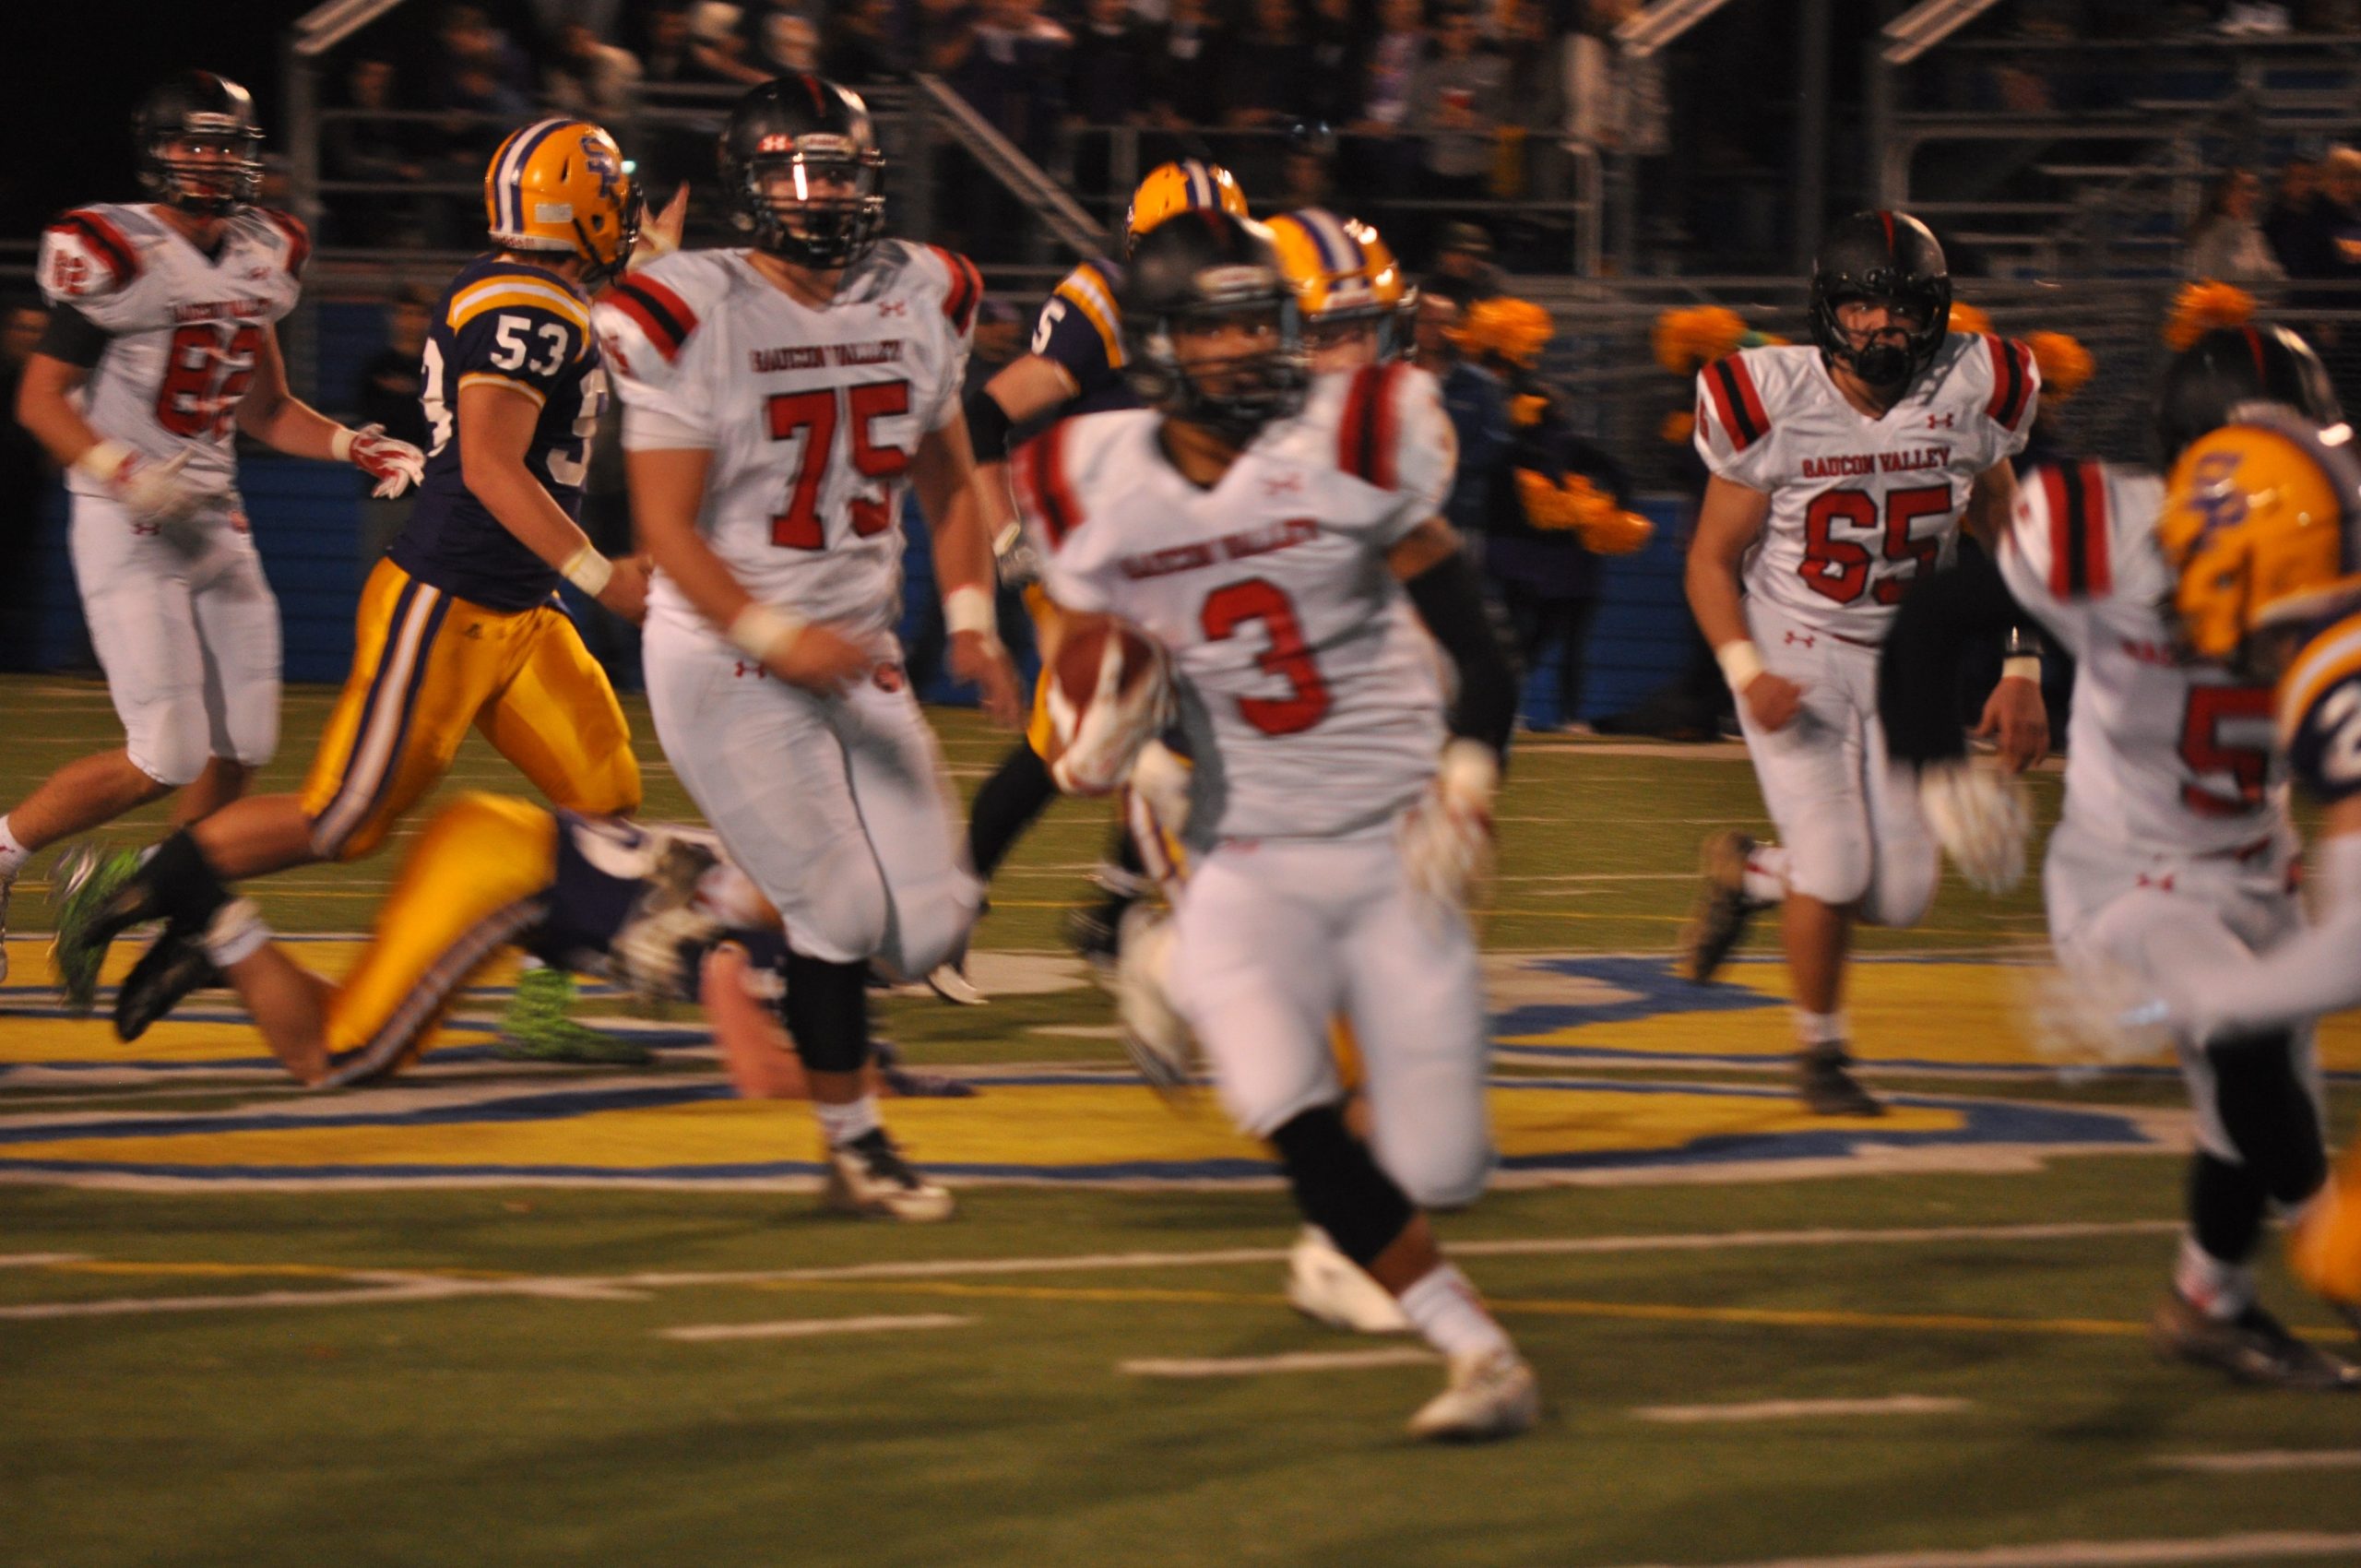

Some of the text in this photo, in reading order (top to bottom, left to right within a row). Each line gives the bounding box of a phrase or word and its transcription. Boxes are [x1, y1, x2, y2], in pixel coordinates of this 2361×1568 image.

[491, 314, 569, 377] 53
[764, 377, 909, 552] 75
[1878, 445, 1952, 473] VALLEY
[1797, 481, 1953, 607] 65
[1201, 574, 1332, 738] 3
[2177, 683, 2278, 819] 5
